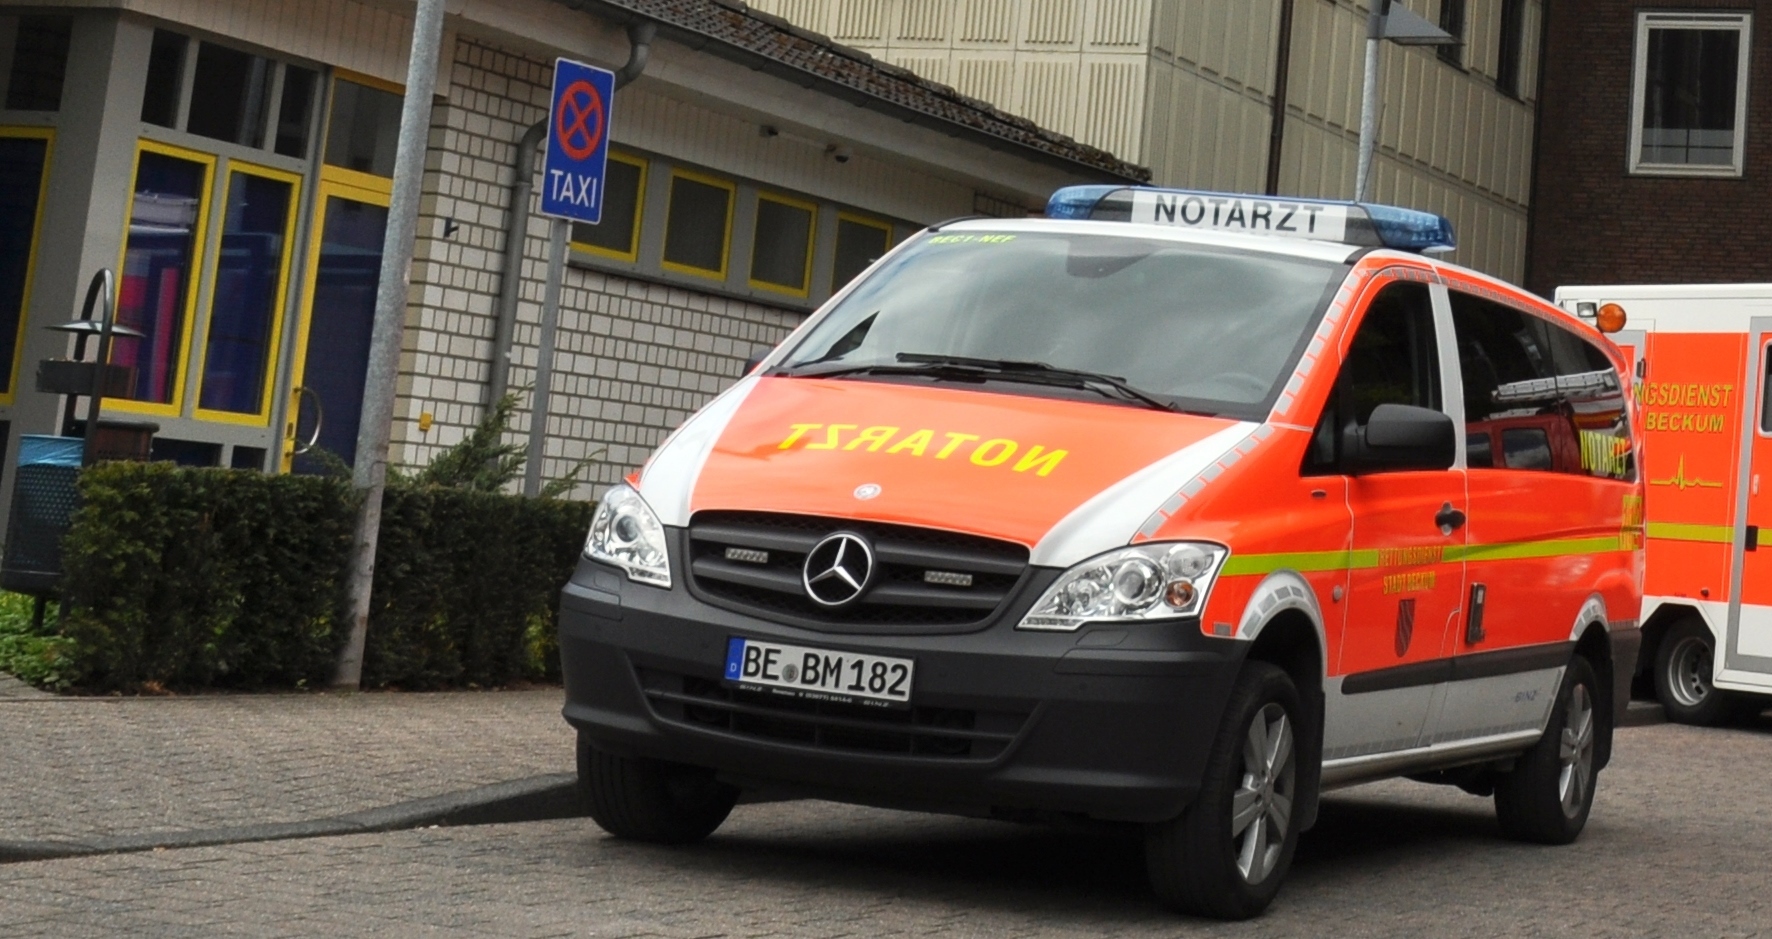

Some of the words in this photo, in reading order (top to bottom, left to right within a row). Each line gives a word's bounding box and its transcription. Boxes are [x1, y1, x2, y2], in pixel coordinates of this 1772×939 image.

[550, 169, 597, 208] TAXI
[1154, 195, 1324, 233] NOTARZT
[1645, 412, 1726, 433] BECKUM
[1580, 429, 1627, 475] NOTARZT
[1379, 546, 1442, 567] RETTUNGSDIENST
[743, 646, 781, 681] BE
[801, 652, 843, 689] BM
[847, 659, 908, 697] 182
